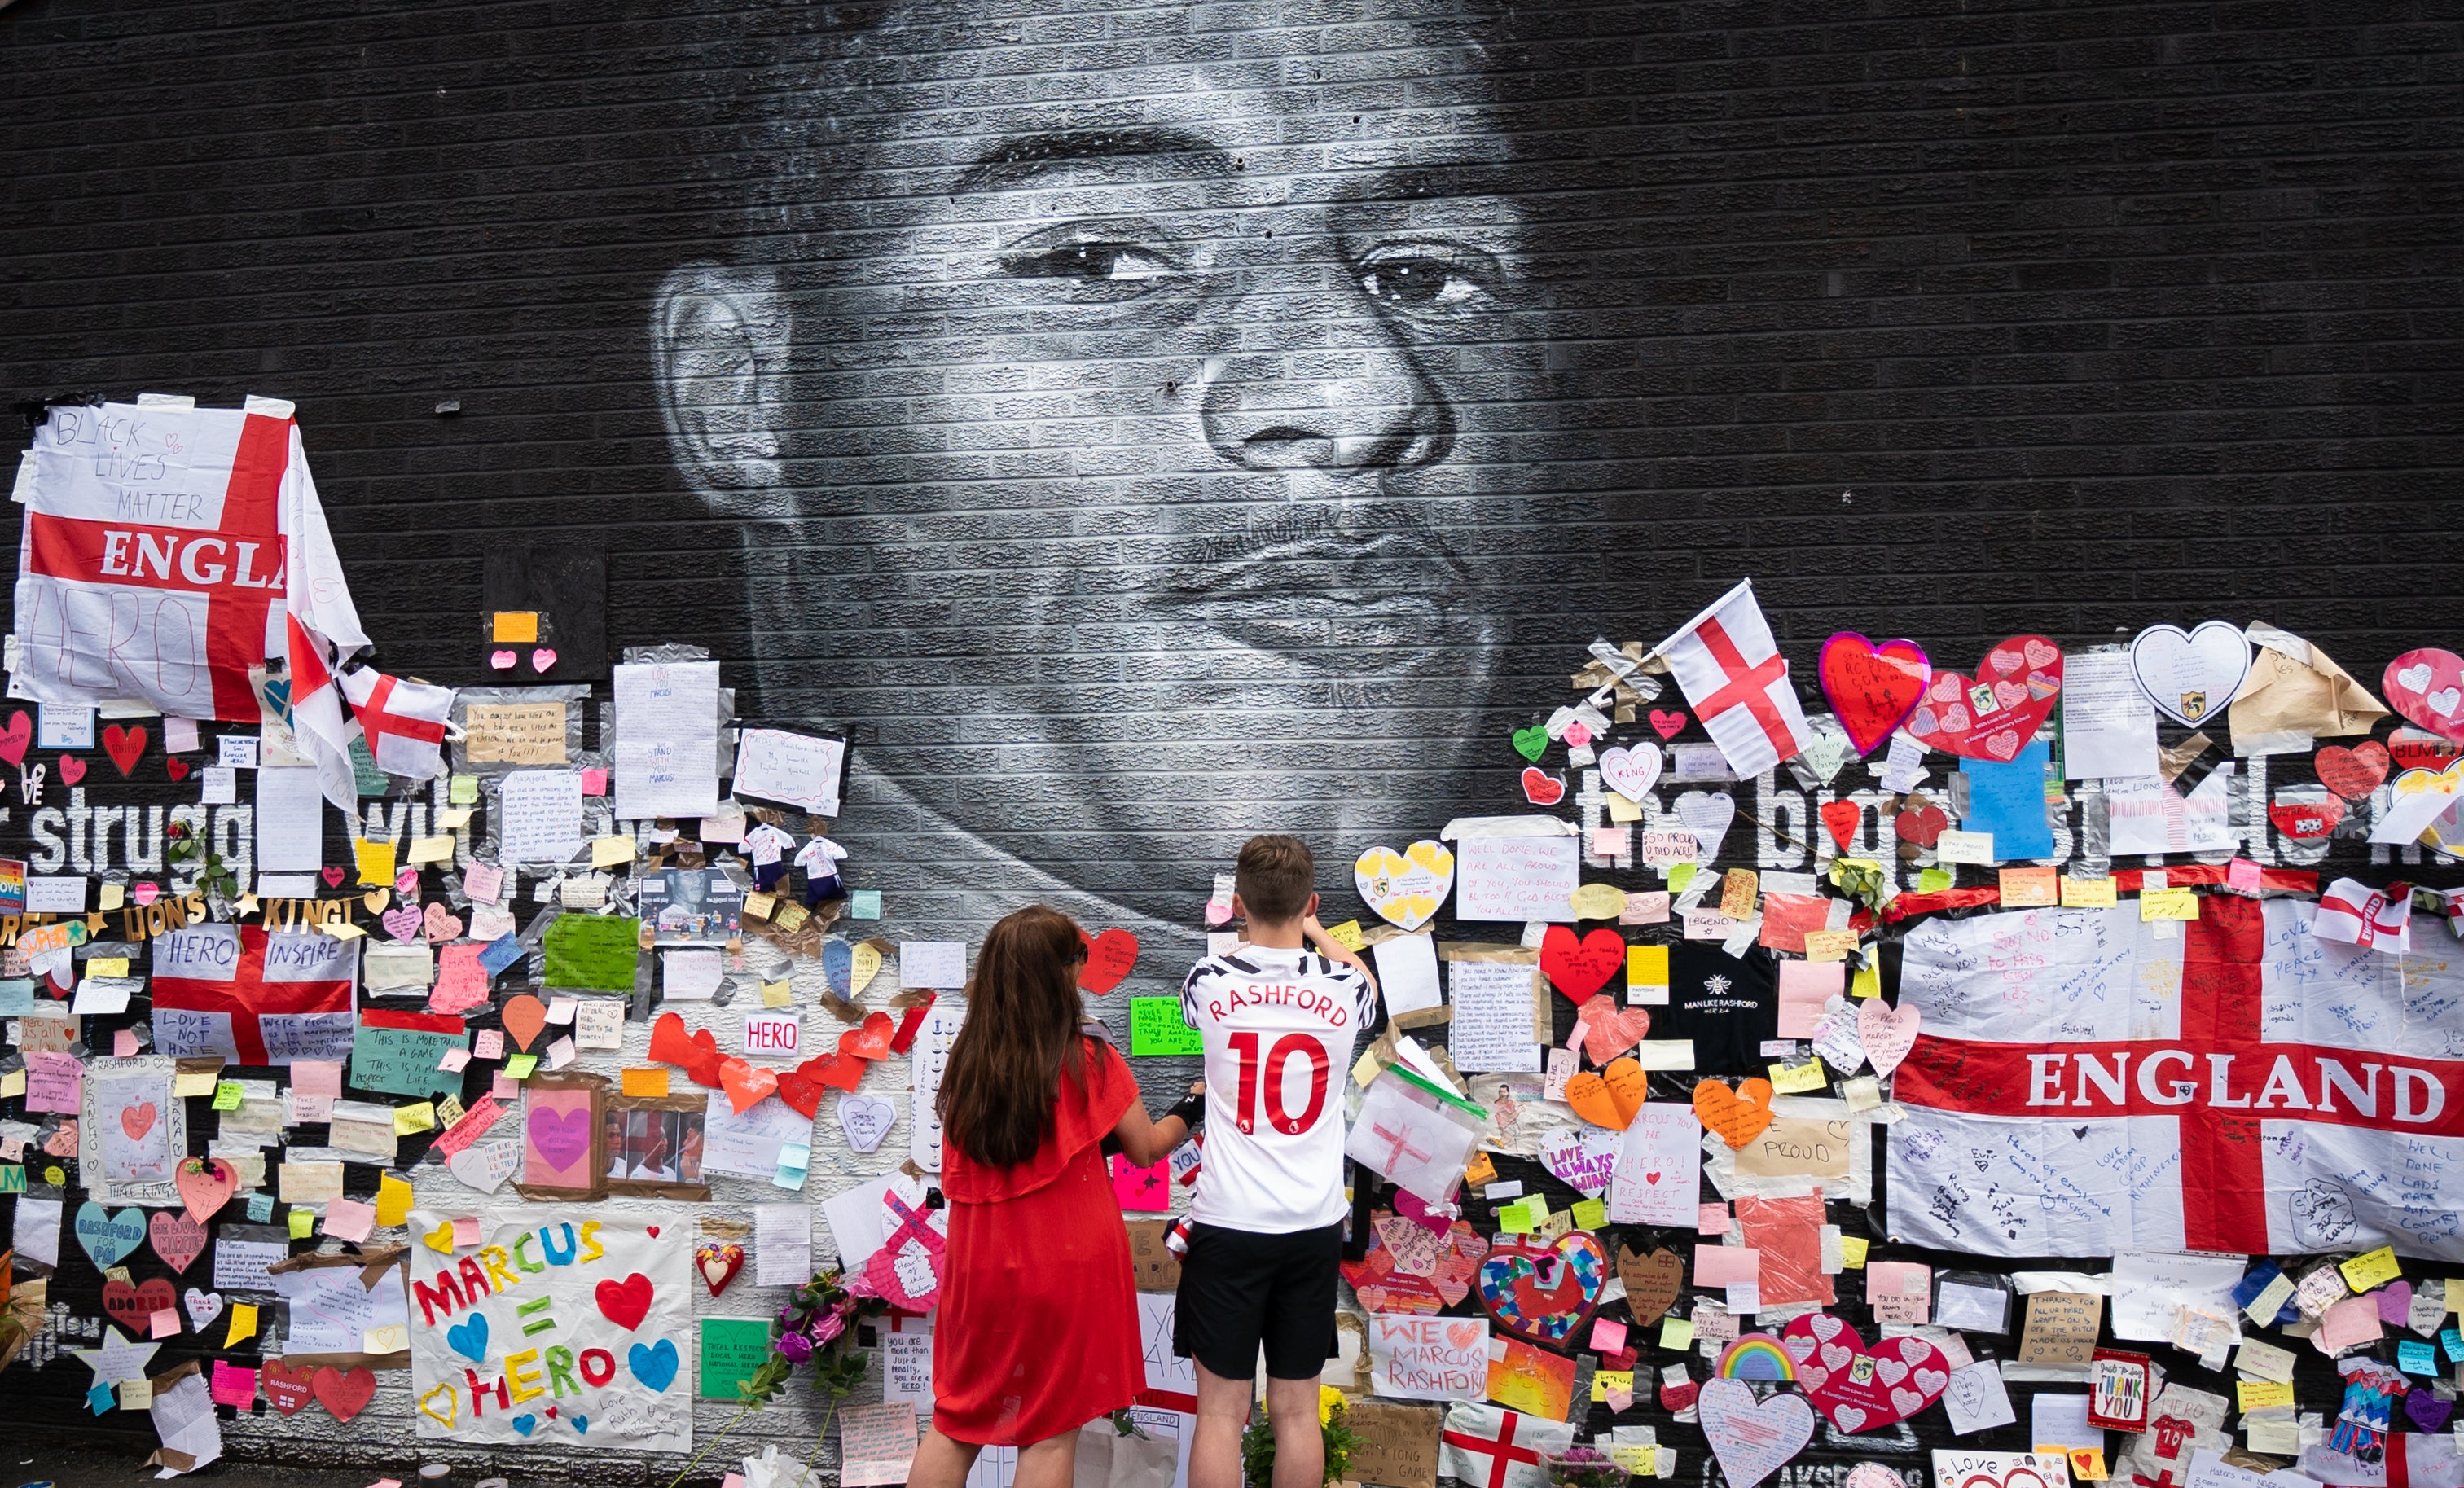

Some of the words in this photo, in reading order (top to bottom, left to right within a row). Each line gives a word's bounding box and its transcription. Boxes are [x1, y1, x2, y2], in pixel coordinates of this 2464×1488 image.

[57, 413, 147, 446] BLACK
[95, 446, 166, 481] LIVES
[118, 490, 202, 520] MATTER
[30, 585, 195, 696] HERO
[652, 669, 671, 680] LOVE
[655, 680, 668, 688] YOU
[1974, 722, 1988, 730] With
[1999, 712, 2011, 721] from
[1996, 720, 2014, 731] Primary
[2015, 713, 2031, 724] School
[648, 747, 671, 758] STAND
[2395, 743, 2440, 758] BLM
[650, 757, 669, 766] WITH
[652, 765, 667, 773] YOU
[1618, 766, 1645, 778] KING
[2132, 781, 2161, 799] LIONS
[1668, 832, 1695, 843] PROUD
[1467, 845, 1496, 855] WELL
[1539, 846, 1557, 855] WE
[1655, 846, 1670, 855] DID
[1466, 863, 1487, 871] ARE
[1496, 862, 1515, 871] ALL
[1524, 862, 1557, 871] PROUD
[1468, 880, 1480, 888] OF
[1512, 878, 1531, 887] YOU
[1535, 879, 1570, 889] SHOULD
[1468, 893, 1480, 901] BE
[1517, 891, 1539, 902] GOD
[1475, 905, 1491, 914] YOU
[1625, 898, 1662, 912] HERO
[124, 893, 205, 942] LIONS
[262, 898, 351, 935] KING!
[2268, 918, 2309, 946] LOVE
[16, 925, 68, 960] SUPER
[170, 936, 235, 965] HERO
[268, 942, 340, 965] INSPIRE
[1955, 955, 1978, 972] YOU
[2086, 947, 2132, 989] COUNTRY
[2274, 948, 2322, 981] PEACE
[1922, 962, 1949, 985] MCR
[454, 986, 477, 998] WIN
[1209, 985, 1347, 1028] RASHFORD
[1720, 1000, 1758, 1009] RASHFORD
[164, 1013, 211, 1027] LOVE
[1862, 1012, 1876, 1021] SO
[1880, 1015, 1904, 1023] PROUD
[178, 1029, 205, 1044] NOT
[371, 1029, 393, 1045] THIS
[402, 1035, 410, 1044] IS
[416, 1034, 437, 1046] MORE
[748, 1021, 797, 1049] HERO
[169, 1044, 217, 1056] HATE
[99, 1058, 147, 1069] RASHFORD
[367, 1060, 392, 1071] THIS
[402, 1063, 409, 1071] IS
[356, 1073, 385, 1082] RESPECT
[1228, 1032, 1330, 1135] 10
[2025, 1049, 2446, 1124] ENGLAND
[86, 1091, 98, 1151] SANCHO
[1676, 1116, 1693, 1129] YOU
[1645, 1130, 1661, 1139] ARE
[497, 1141, 511, 1151] MAKE
[1763, 1141, 1829, 1163] PROUD
[499, 1149, 516, 1160] WORLD
[1172, 1147, 1201, 1172] YOU
[1550, 1145, 1583, 1165] LOVE
[2096, 1147, 2123, 1168] LOVE
[494, 1161, 514, 1170] BETTER
[1553, 1152, 1614, 1179] ALWAYS
[490, 1171, 507, 1180] PLACE
[1570, 1171, 1612, 1192] WINS
[109, 1185, 137, 1198] THREE
[143, 1182, 176, 1198] KINGS
[2401, 1177, 2440, 1191] LADS
[897, 1184, 910, 1200] best
[1619, 1187, 1680, 1199] RESPECT
[152, 1223, 168, 1233] WE
[172, 1221, 196, 1233] LOVE
[2400, 1211, 2459, 1230] COUNTRY
[79, 1219, 142, 1241] RASHFORD
[97, 1236, 115, 1246] FOR
[159, 1236, 202, 1254] MARCUS
[94, 1247, 116, 1264] PM
[897, 1257, 922, 1269] Heart
[413, 1220, 604, 1327] MARCUS
[910, 1276, 925, 1284] the
[109, 1297, 169, 1311] ADORED
[188, 1296, 211, 1304] Thank
[2033, 1296, 2073, 1304] THANKS
[2412, 1306, 2432, 1314] Thank
[1373, 1315, 1442, 1345] WE
[708, 1343, 729, 1351] TOTAL
[733, 1344, 766, 1352] RESPECT
[908, 1337, 922, 1345] are
[710, 1352, 731, 1360] LOCAL
[911, 1346, 929, 1354] than
[1394, 1345, 1484, 1369] MARCUS
[270, 1379, 307, 1394] RASHFORD
[464, 1344, 617, 1417] HERO
[1388, 1361, 1486, 1398] RASHFORD
[1956, 1380, 1973, 1392] Hope
[2098, 1375, 2142, 1401] THANK
[599, 1394, 626, 1411] Love
[1853, 1398, 1870, 1407] Primary
[1871, 1403, 1889, 1412] School
[2104, 1395, 2133, 1419] YOU
[2160, 1398, 2204, 1419] HERO
[609, 1407, 637, 1429] Ruth
[1131, 1411, 1176, 1425] ENGLAND
[2163, 1429, 2180, 1446] 10
[1392, 1449, 1420, 1463] LONG
[1399, 1464, 1427, 1477] GAME
[1519, 1467, 1537, 1477] AND
[2209, 1467, 2235, 1479] Haters
